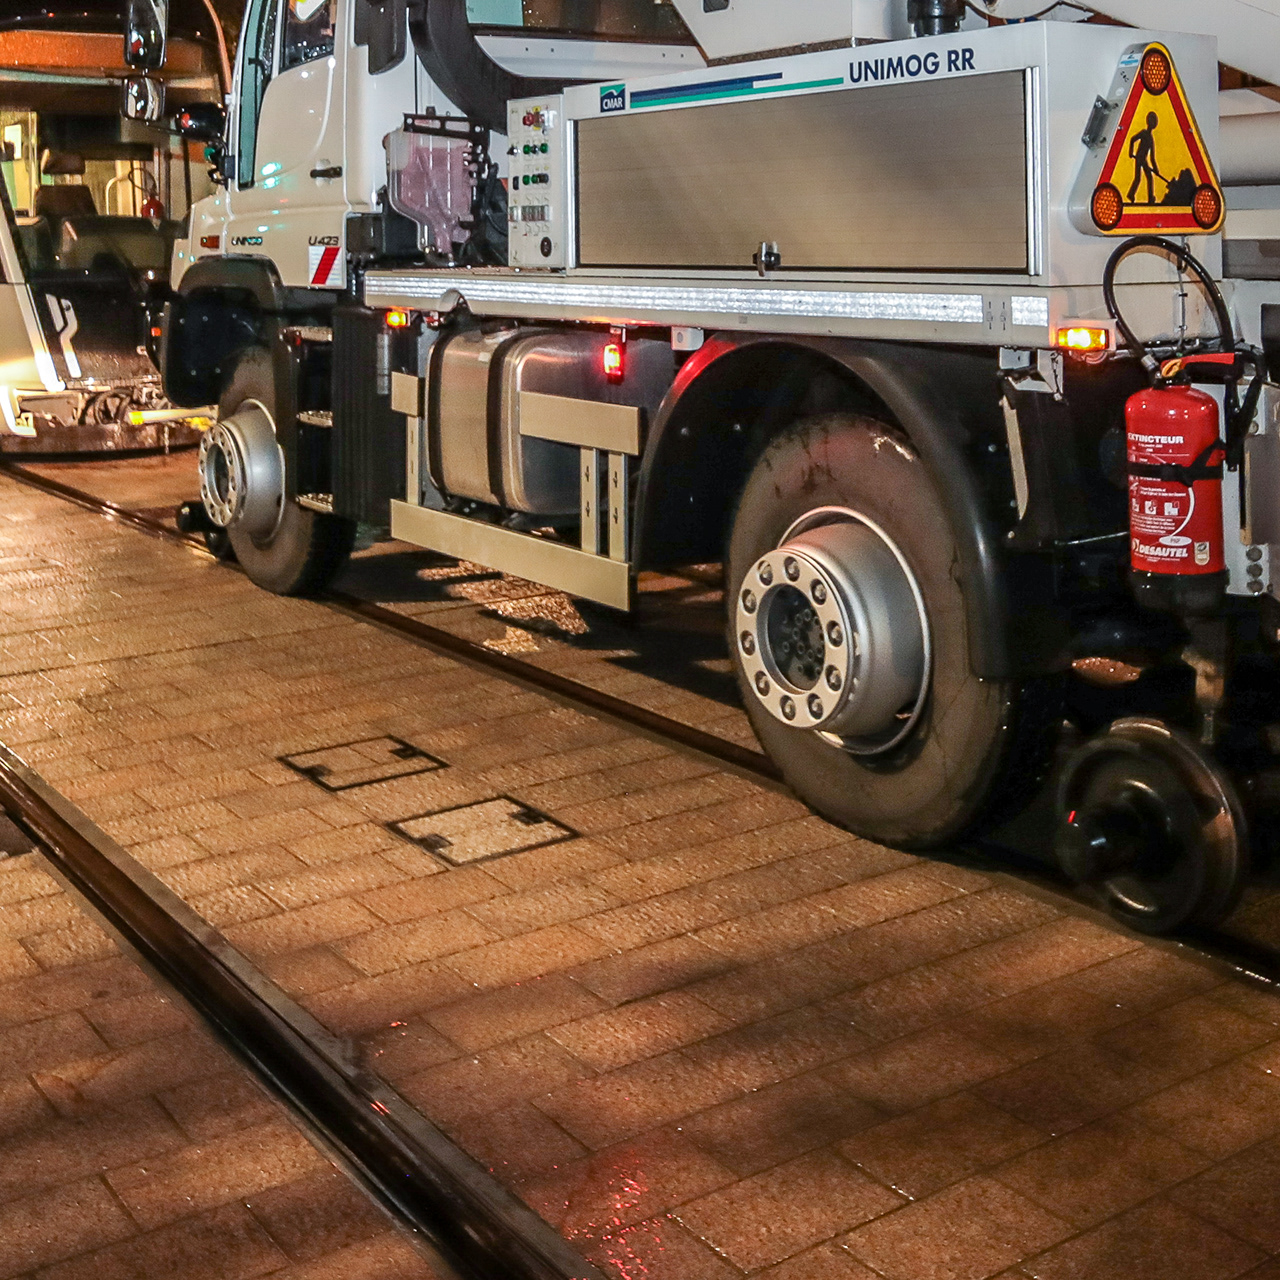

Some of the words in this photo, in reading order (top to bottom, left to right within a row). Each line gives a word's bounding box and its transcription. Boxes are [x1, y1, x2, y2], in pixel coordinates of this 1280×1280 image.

[848, 51, 940, 83] UNIMOG
[946, 47, 975, 72] RR
[602, 97, 624, 110] CMAR
